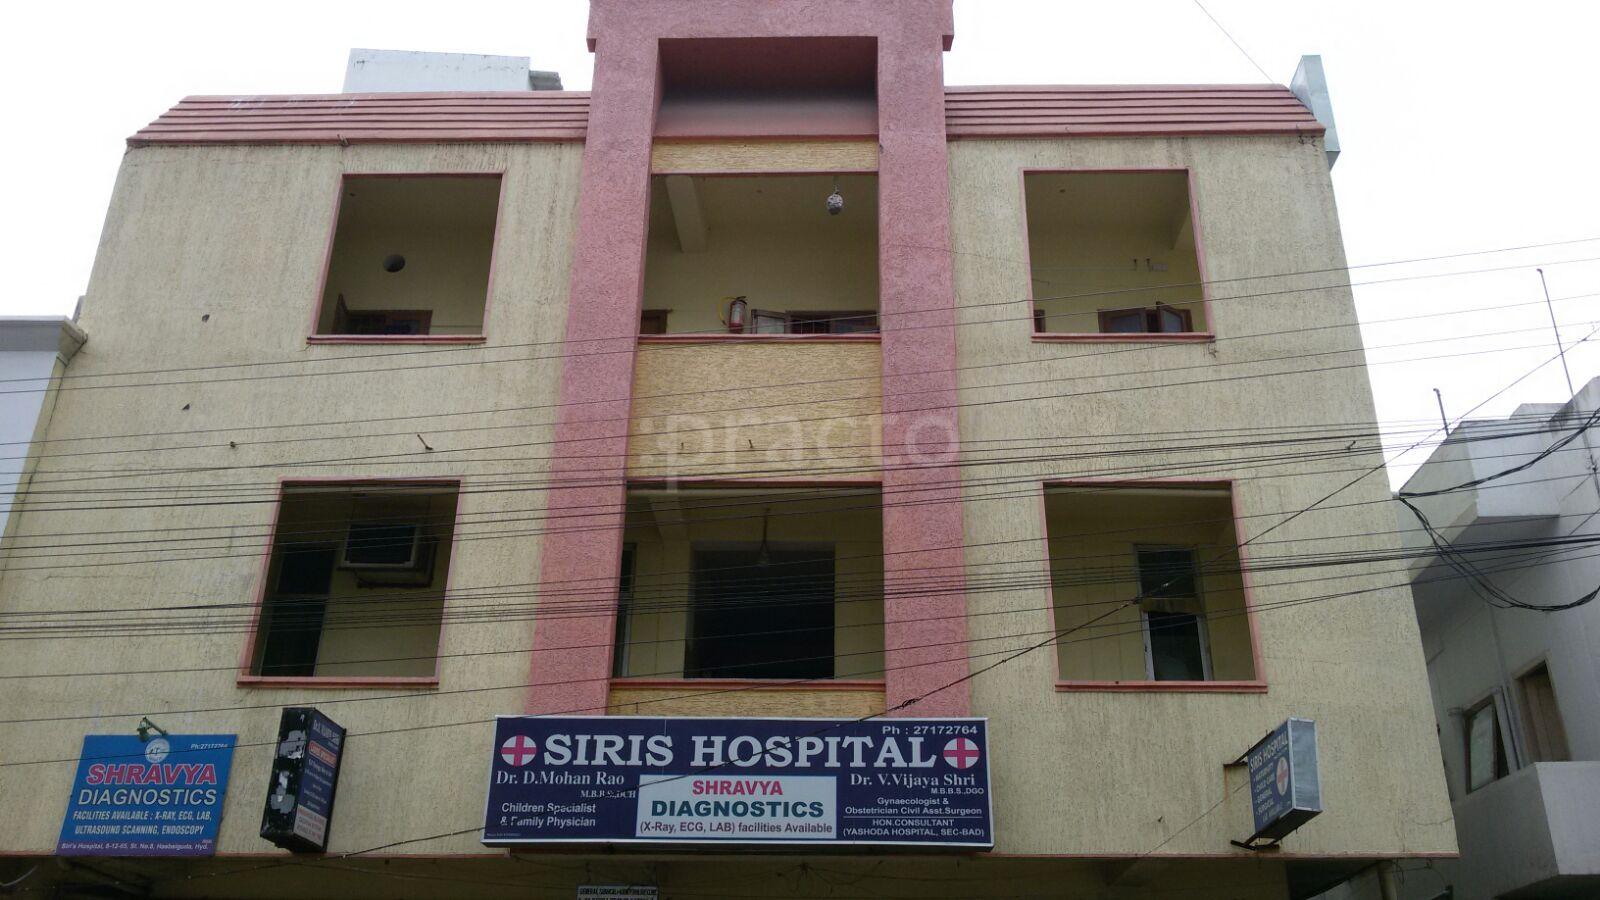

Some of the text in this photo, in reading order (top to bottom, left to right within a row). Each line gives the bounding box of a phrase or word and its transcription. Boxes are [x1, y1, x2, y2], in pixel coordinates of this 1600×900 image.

[882, 725, 900, 735] Ph
[912, 725, 978, 735] 27172764
[543, 734, 937, 768] SIRIS HOSPITAL
[86, 763, 218, 786] SHRAVYA
[496, 770, 625, 786] Dr. D.Mohan Rao
[850, 773, 975, 789] Dr. V.Vijaya Shri
[692, 780, 783, 796] SHRAVYA
[78, 788, 217, 806] DIAGNOSTICS
[877, 797, 949, 806] Gynaecologist &
[501, 802, 596, 815] Children Specialist
[651, 800, 824, 818] DIAGNOSTICS
[845, 806, 982, 816] Obstetrician Civil Asst.Surgeon
[73, 810, 110, 821] FACILITIES
[111, 810, 149, 821] AVAILABLE
[154, 810, 177, 822] X-RAY,
[196, 810, 212, 822] LAB,
[500, 816, 596, 828] & Family Physician
[640, 822, 833, 834] (X-Ray, ECG, LAB) facilities Available
[872, 819, 954, 827] HON.CONSULTANT
[75, 824, 204, 836] ULTRASOUND SCANNING, ENDOSCOPY
[843, 828, 985, 838] (YASHODA HOSPITAL, SEC-BAD)
